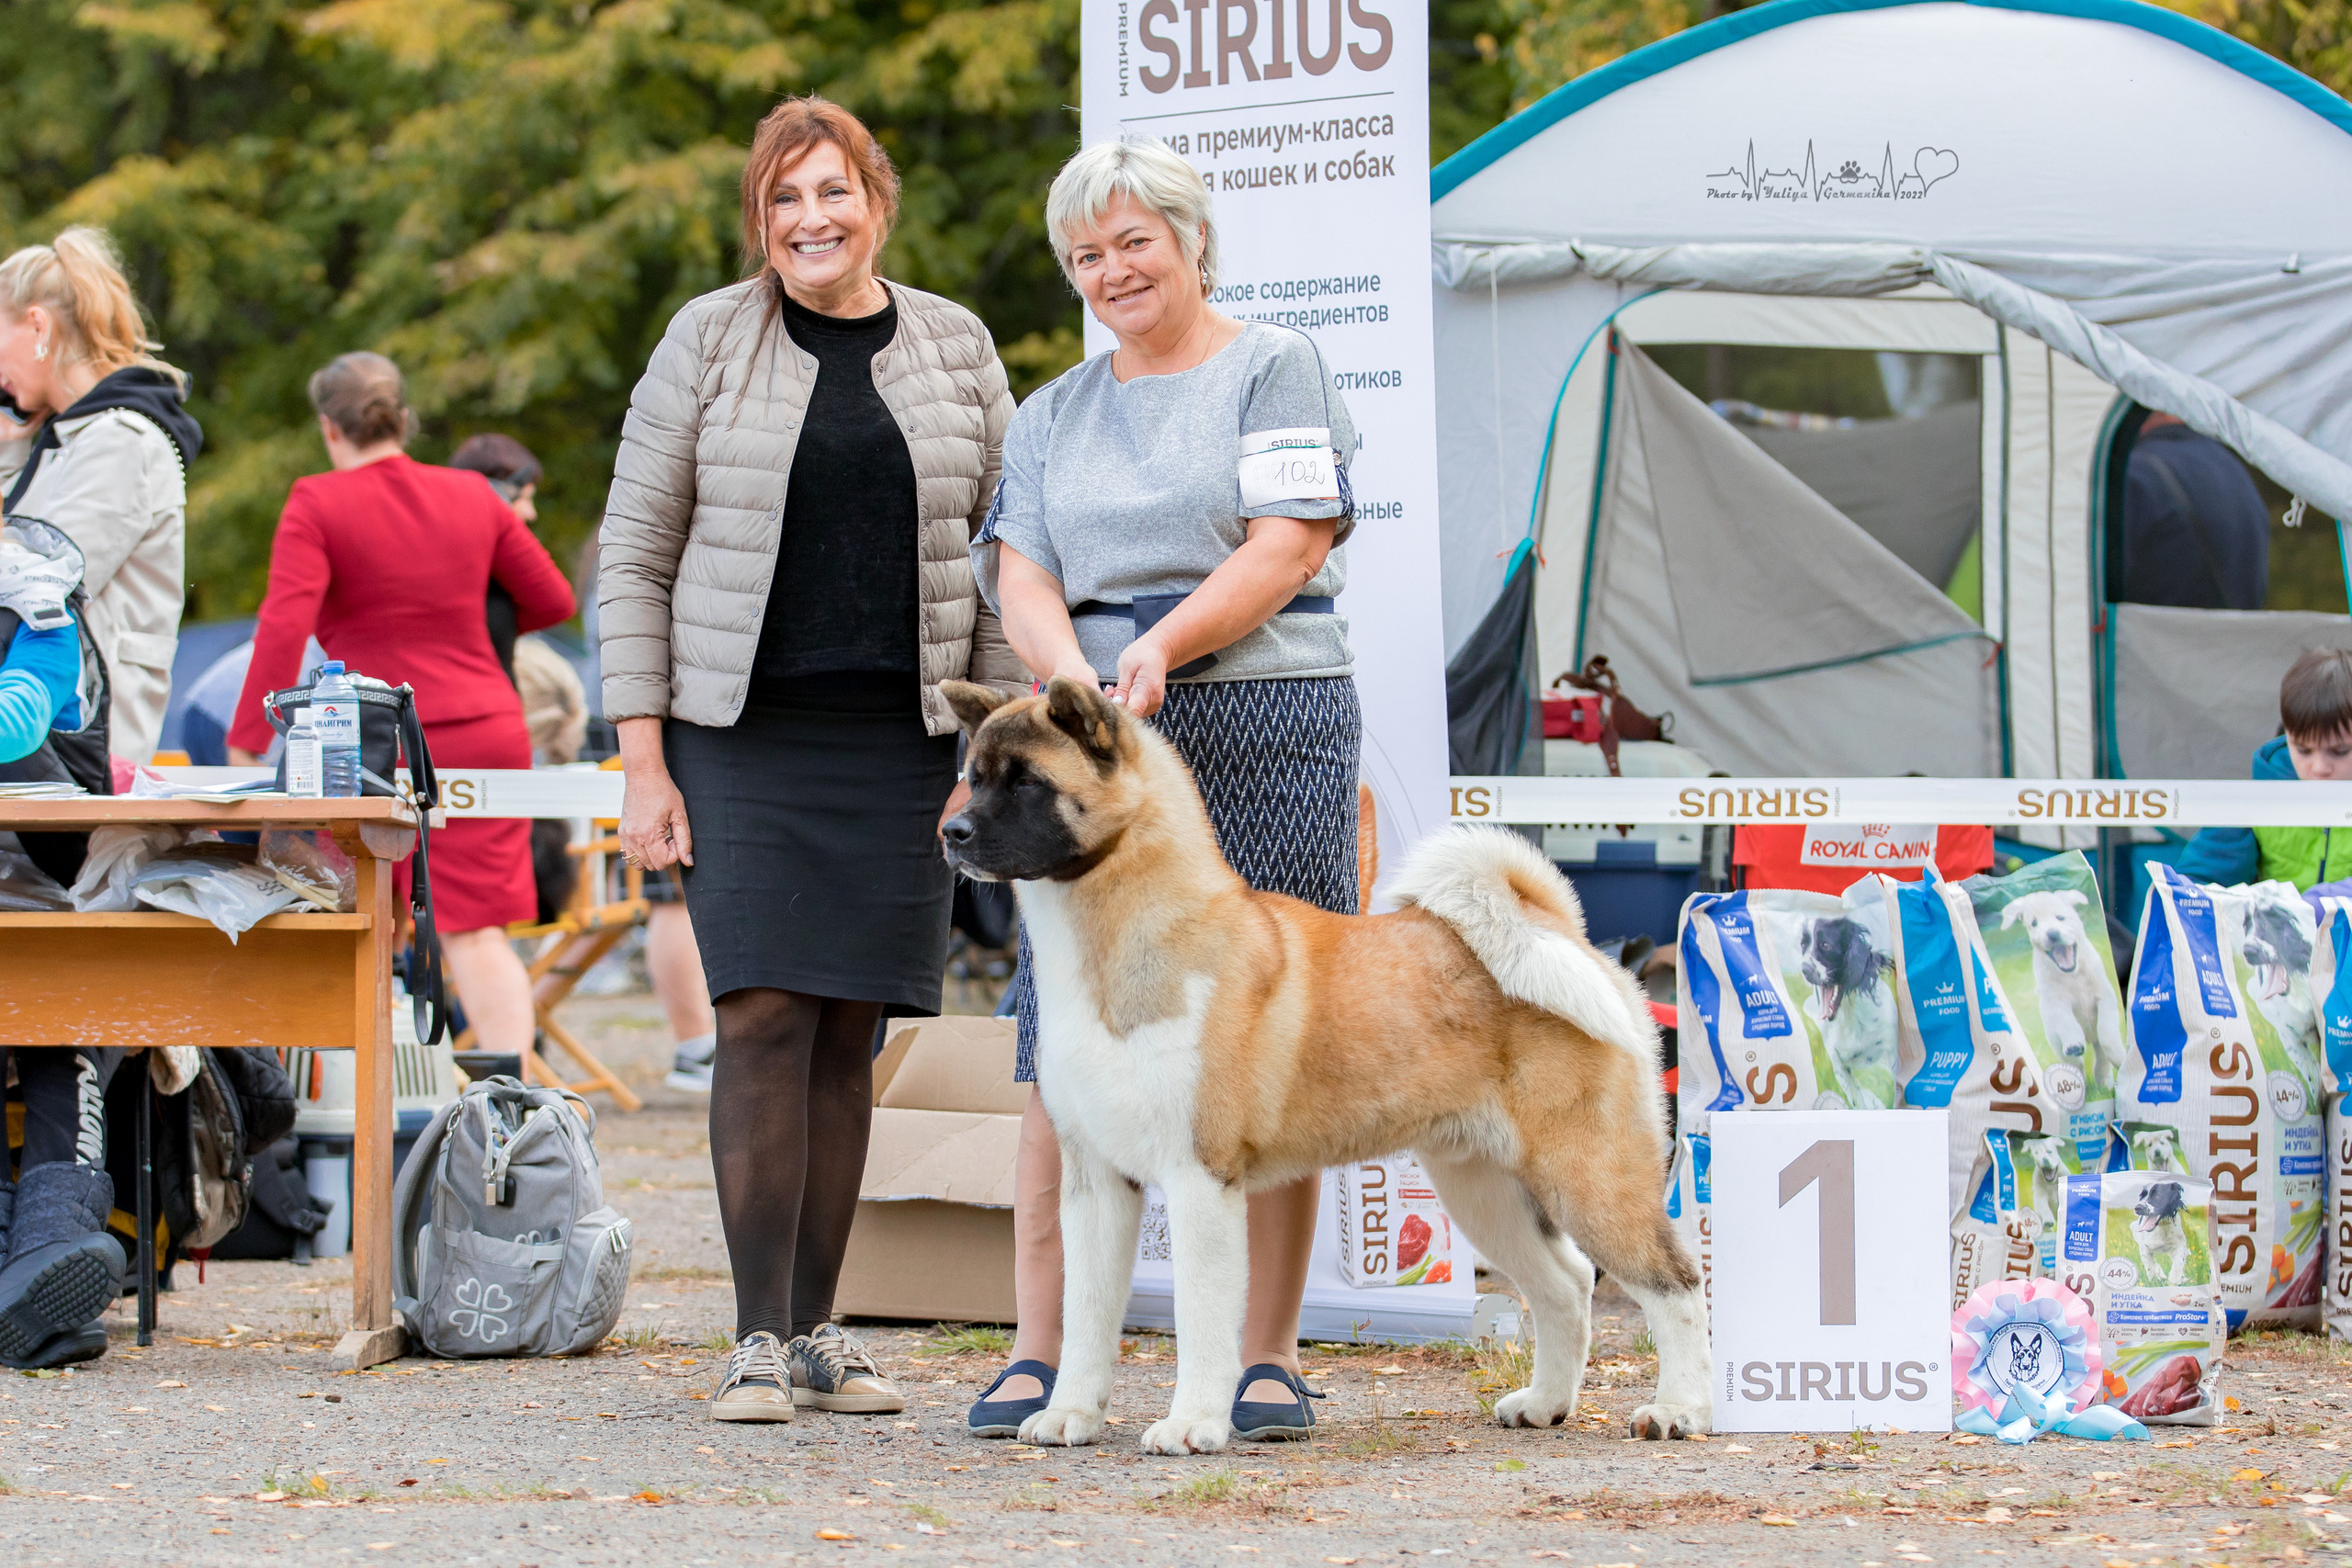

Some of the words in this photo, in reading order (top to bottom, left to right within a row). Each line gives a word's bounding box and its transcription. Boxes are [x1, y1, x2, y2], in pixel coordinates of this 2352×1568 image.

[1118, 2, 1128, 96] PREMIUM
[1138, 0, 1393, 94] SIRIUS
[1197, 114, 1394, 158] премиум-класса
[1223, 162, 1296, 190] кошек
[1305, 162, 1317, 183] и
[1325, 150, 1396, 181] собак
[1261, 274, 1381, 301] содержание
[1334, 369, 1402, 390] отиков
[1274, 460, 1325, 486] 102
[1810, 839, 1867, 859] ROYAL
[1868, 839, 1929, 860] CANIN
[1746, 990, 1778, 1008] ADULT
[1939, 1007, 1960, 1015] FOOD
[1929, 1051, 1968, 1068] PUPPY
[2056, 1079, 2081, 1094] 48%
[2275, 1089, 2300, 1103] 44%
[1361, 1165, 1388, 1275] SIRIU
[1779, 1139, 1856, 1325] 1
[2069, 1230, 2094, 1243] ADULT
[2107, 1269, 2132, 1278] 44%
[2110, 1292, 2155, 1303] ИНДЕЙКА
[2120, 1301, 2143, 1309] УТКА
